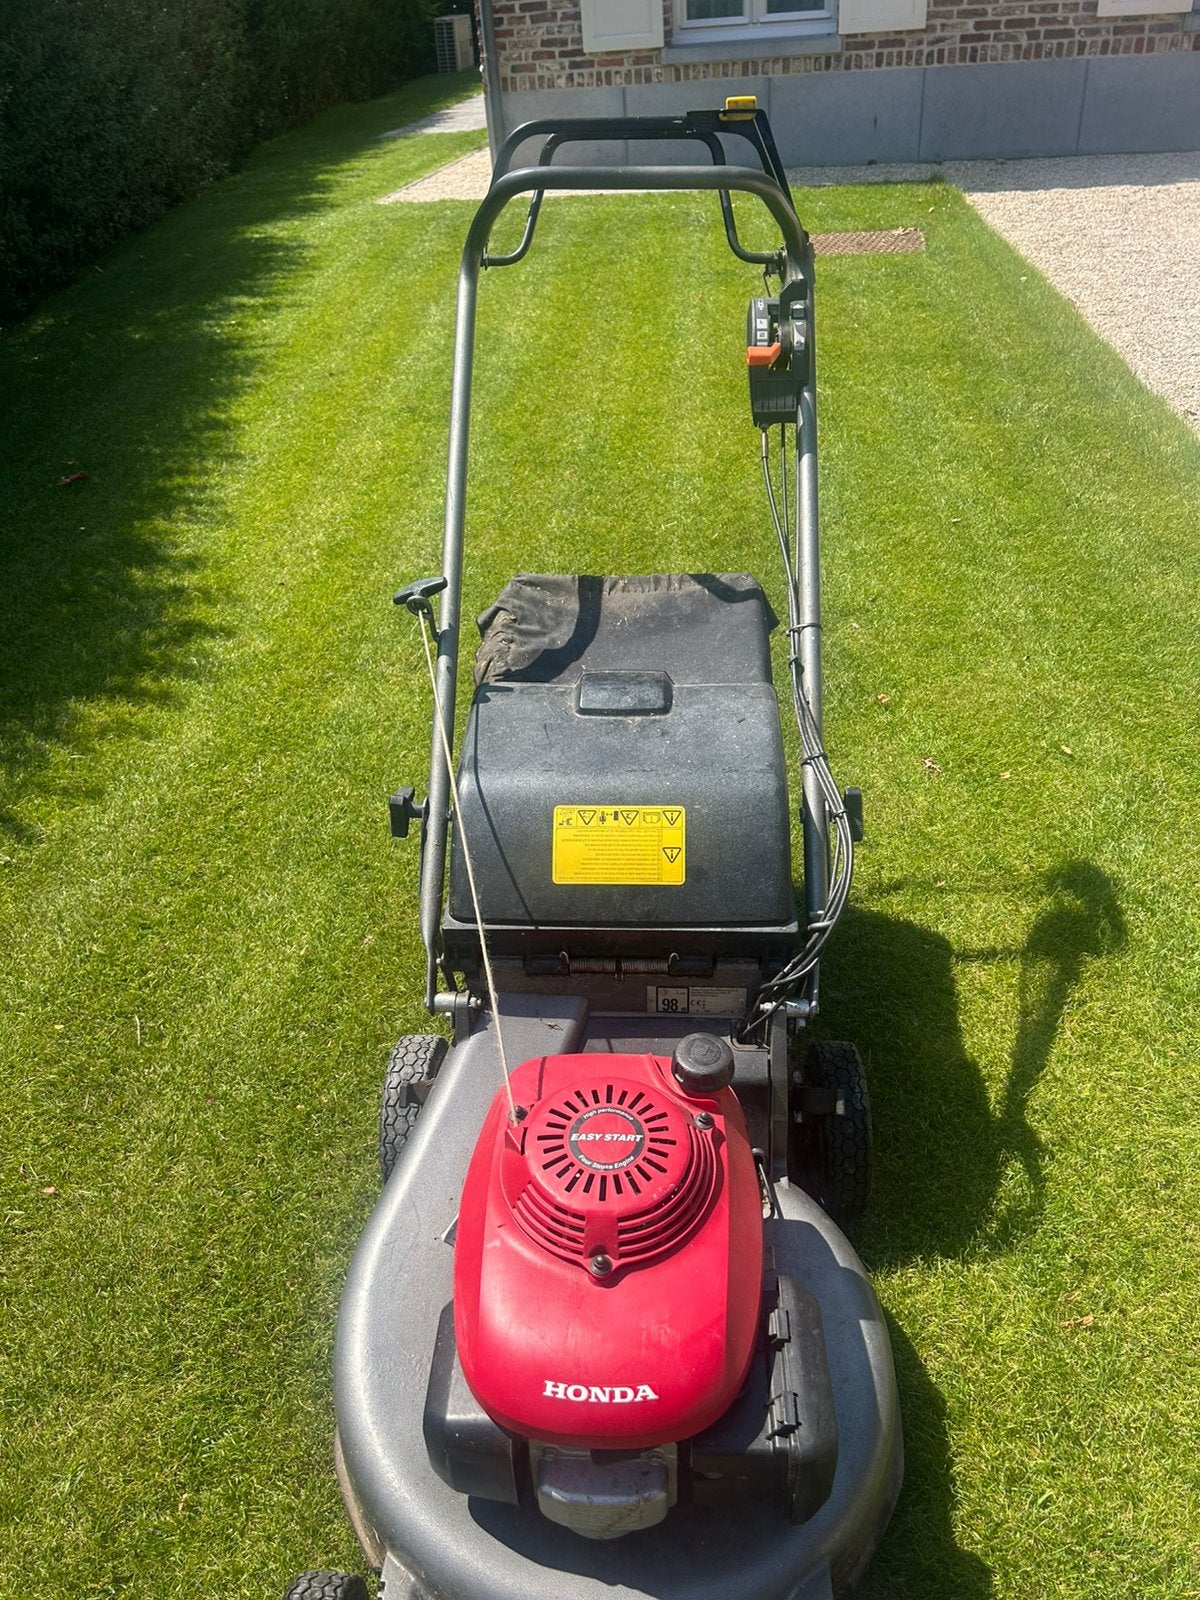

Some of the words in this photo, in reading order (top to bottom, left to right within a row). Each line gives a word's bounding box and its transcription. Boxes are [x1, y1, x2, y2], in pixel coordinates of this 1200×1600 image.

[662, 998, 679, 1011] 98
[583, 1110, 597, 1120] High
[597, 1107, 635, 1121] performance
[570, 1133, 603, 1142] EASY
[604, 1133, 643, 1143] START
[578, 1154, 592, 1166] Four
[591, 1161, 613, 1170] Stroke
[614, 1155, 635, 1169] Engine
[542, 1380, 659, 1403] HONDA
